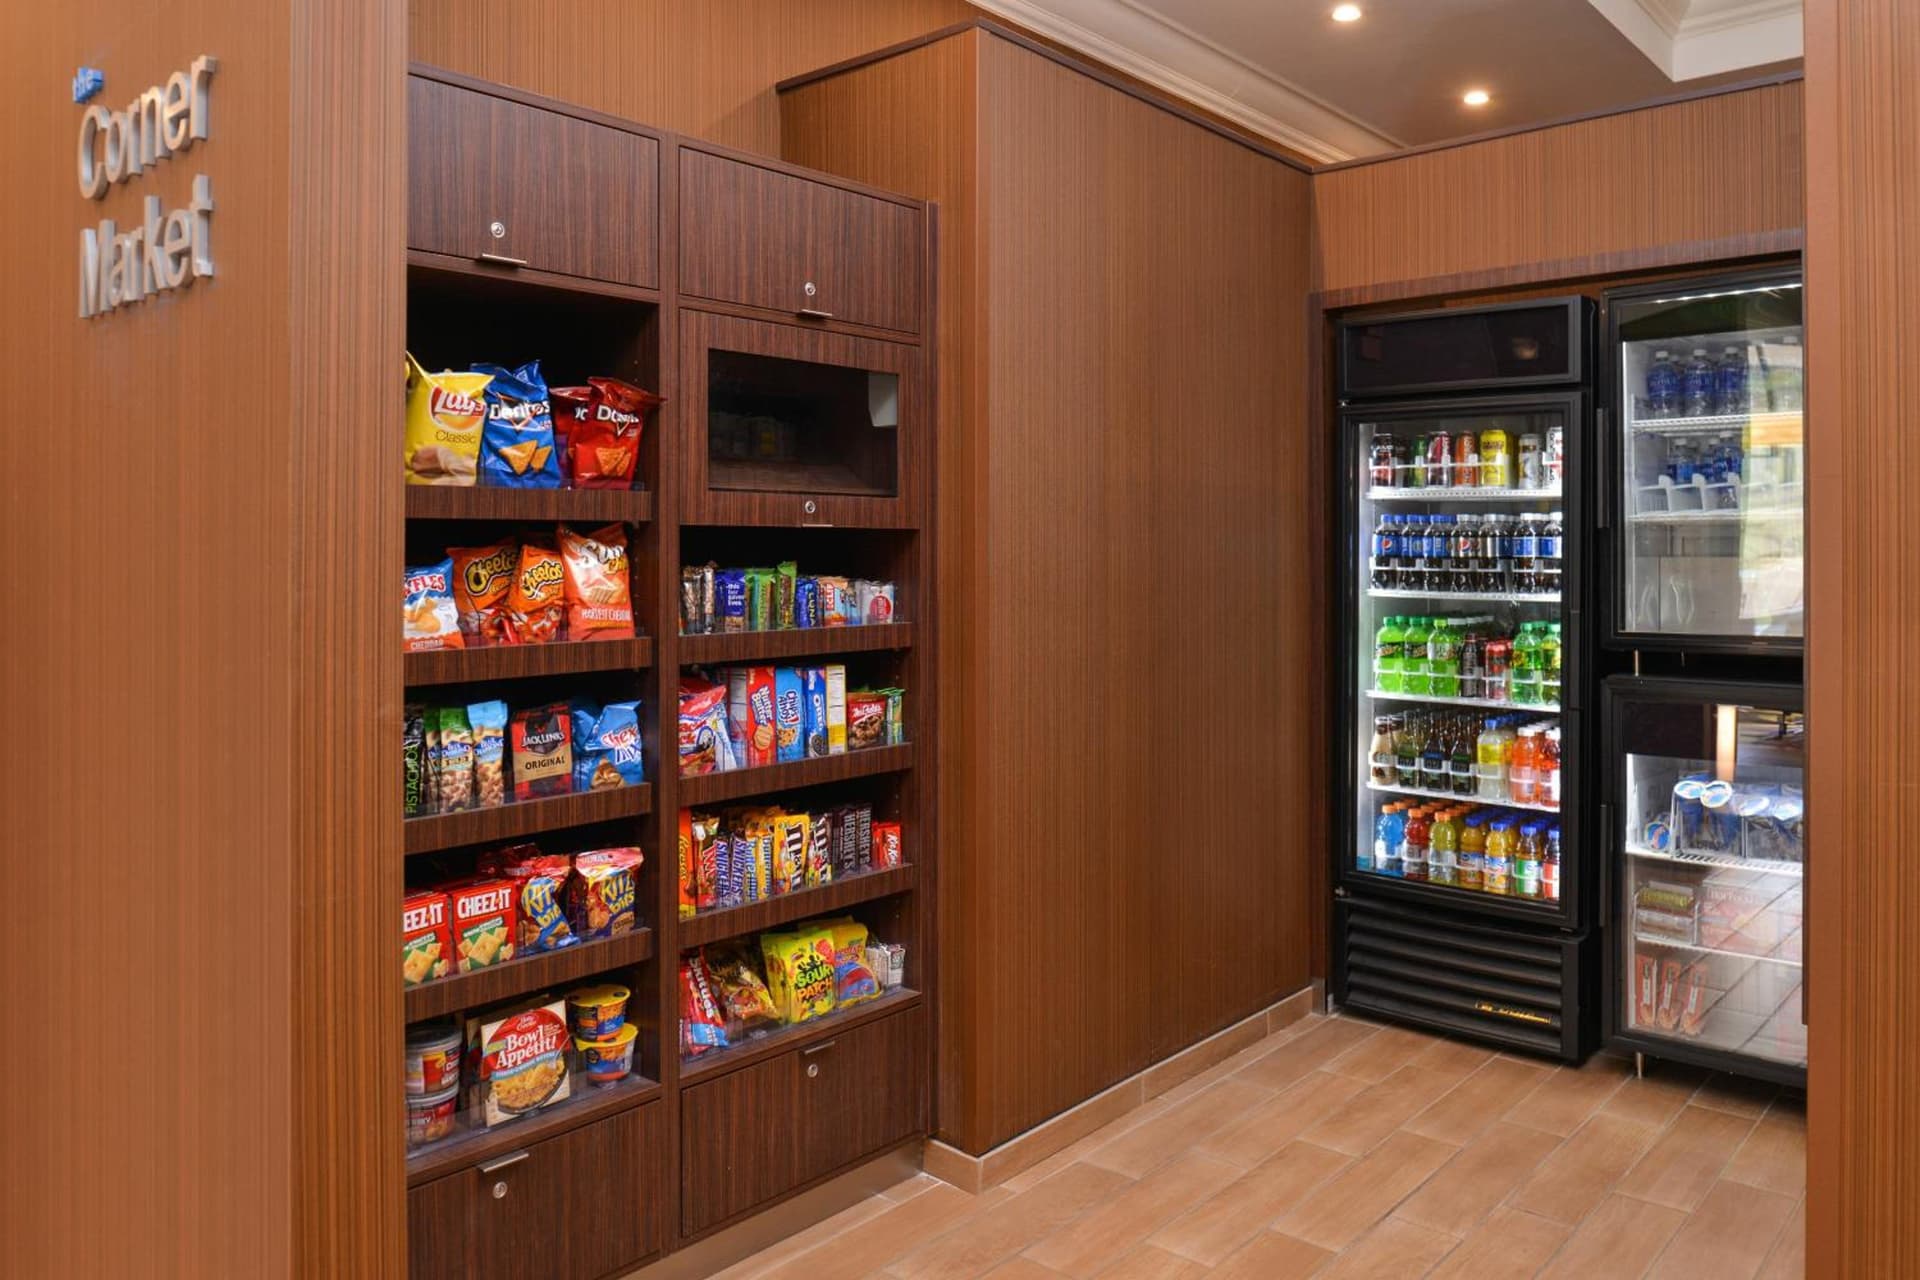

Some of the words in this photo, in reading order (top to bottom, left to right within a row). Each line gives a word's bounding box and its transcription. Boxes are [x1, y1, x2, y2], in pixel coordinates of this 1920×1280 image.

[72, 66, 104, 103] the
[78, 54, 217, 200] Corner
[79, 173, 215, 319] Market
[489, 401, 550, 420] Doritos
[434, 430, 477, 444] Classic
[522, 560, 564, 598] Cheetos
[751, 690, 768, 727] Butter
[758, 684, 773, 721] Nutter
[521, 735, 544, 747] JACK
[600, 725, 638, 748] Chex
[525, 757, 566, 770] ORIGINAL
[843, 813, 856, 869] HERSHEY'S
[858, 807, 871, 865] HERSHEY'S
[716, 842, 730, 897] SNICKERS
[731, 837, 746, 900] SNICKERS
[796, 966, 834, 988] SOUR
[797, 979, 833, 1002] PATCH
[505, 1024, 545, 1053] Bowl
